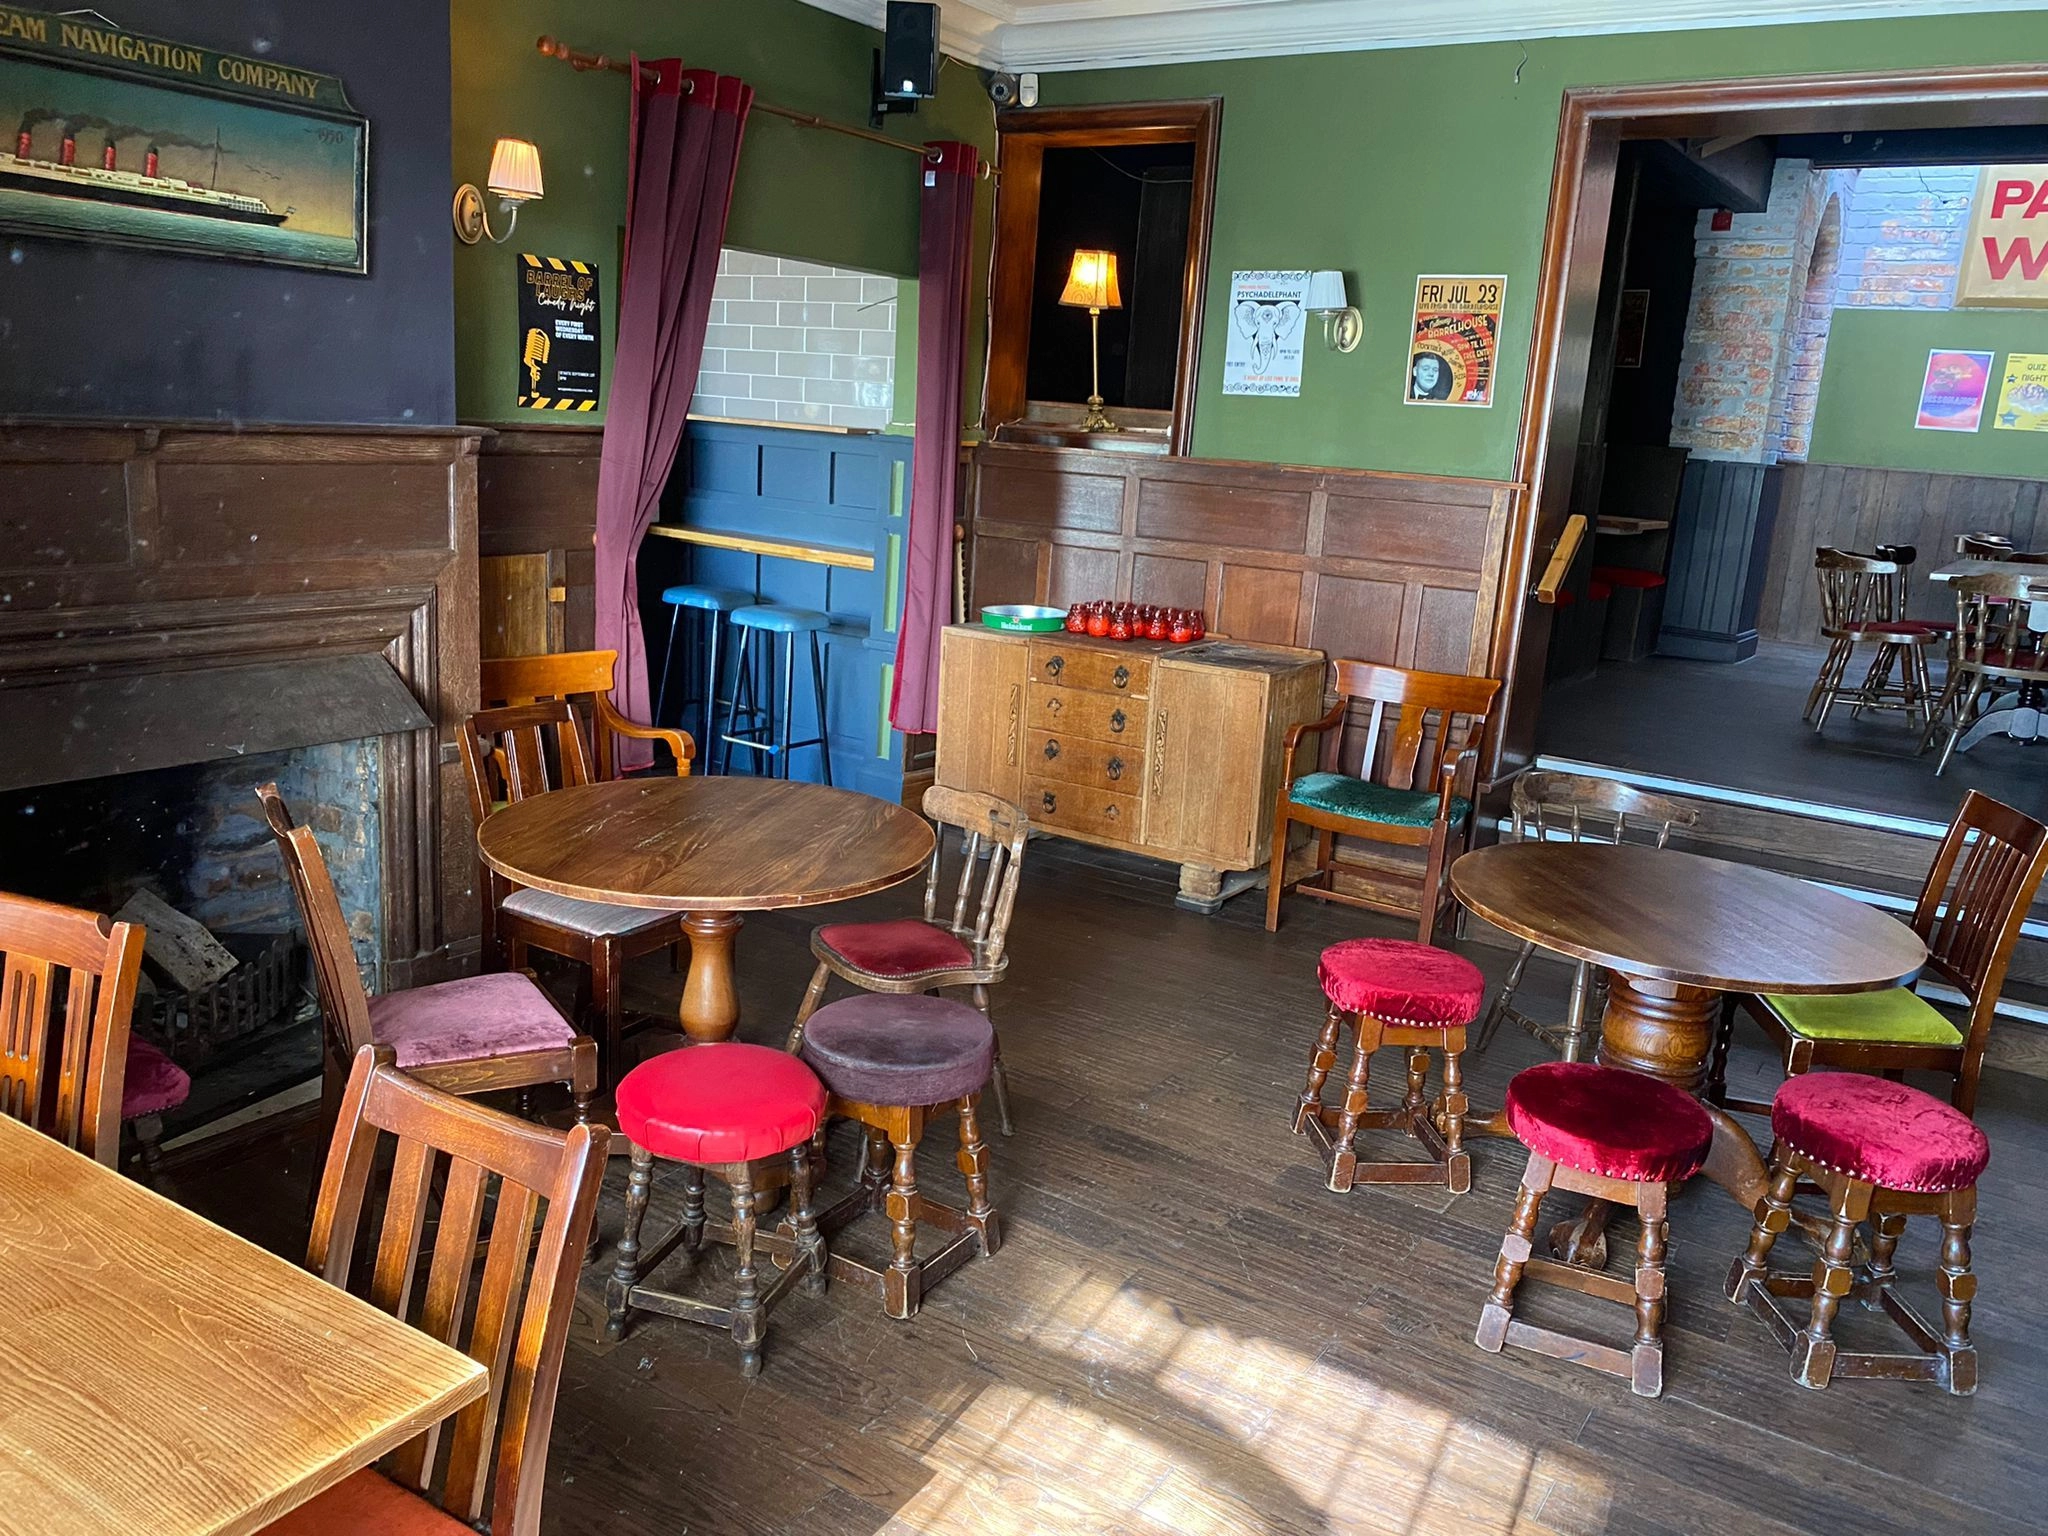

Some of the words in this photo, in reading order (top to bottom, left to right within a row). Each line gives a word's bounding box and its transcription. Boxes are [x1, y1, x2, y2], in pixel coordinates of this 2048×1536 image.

[61, 23, 203, 74] NAVIGATION
[218, 58, 320, 100] COMPANY
[526, 269, 574, 289] BARREL
[577, 276, 594, 291] OF
[536, 283, 586, 302] LAUGHS
[1237, 290, 1302, 298] PSYCHADELEPHANT
[1421, 285, 1444, 303] FRI
[1447, 285, 1471, 303] JUL
[1477, 284, 1497, 304] 23
[537, 292, 567, 311] Comedy
[569, 297, 596, 316] Night
[1427, 314, 1488, 339] BARRELHOUSE
[2027, 363, 2046, 371] QUIZ
[2021, 374, 2048, 382] NIGHT
[1001, 621, 1033, 631] Heineken
